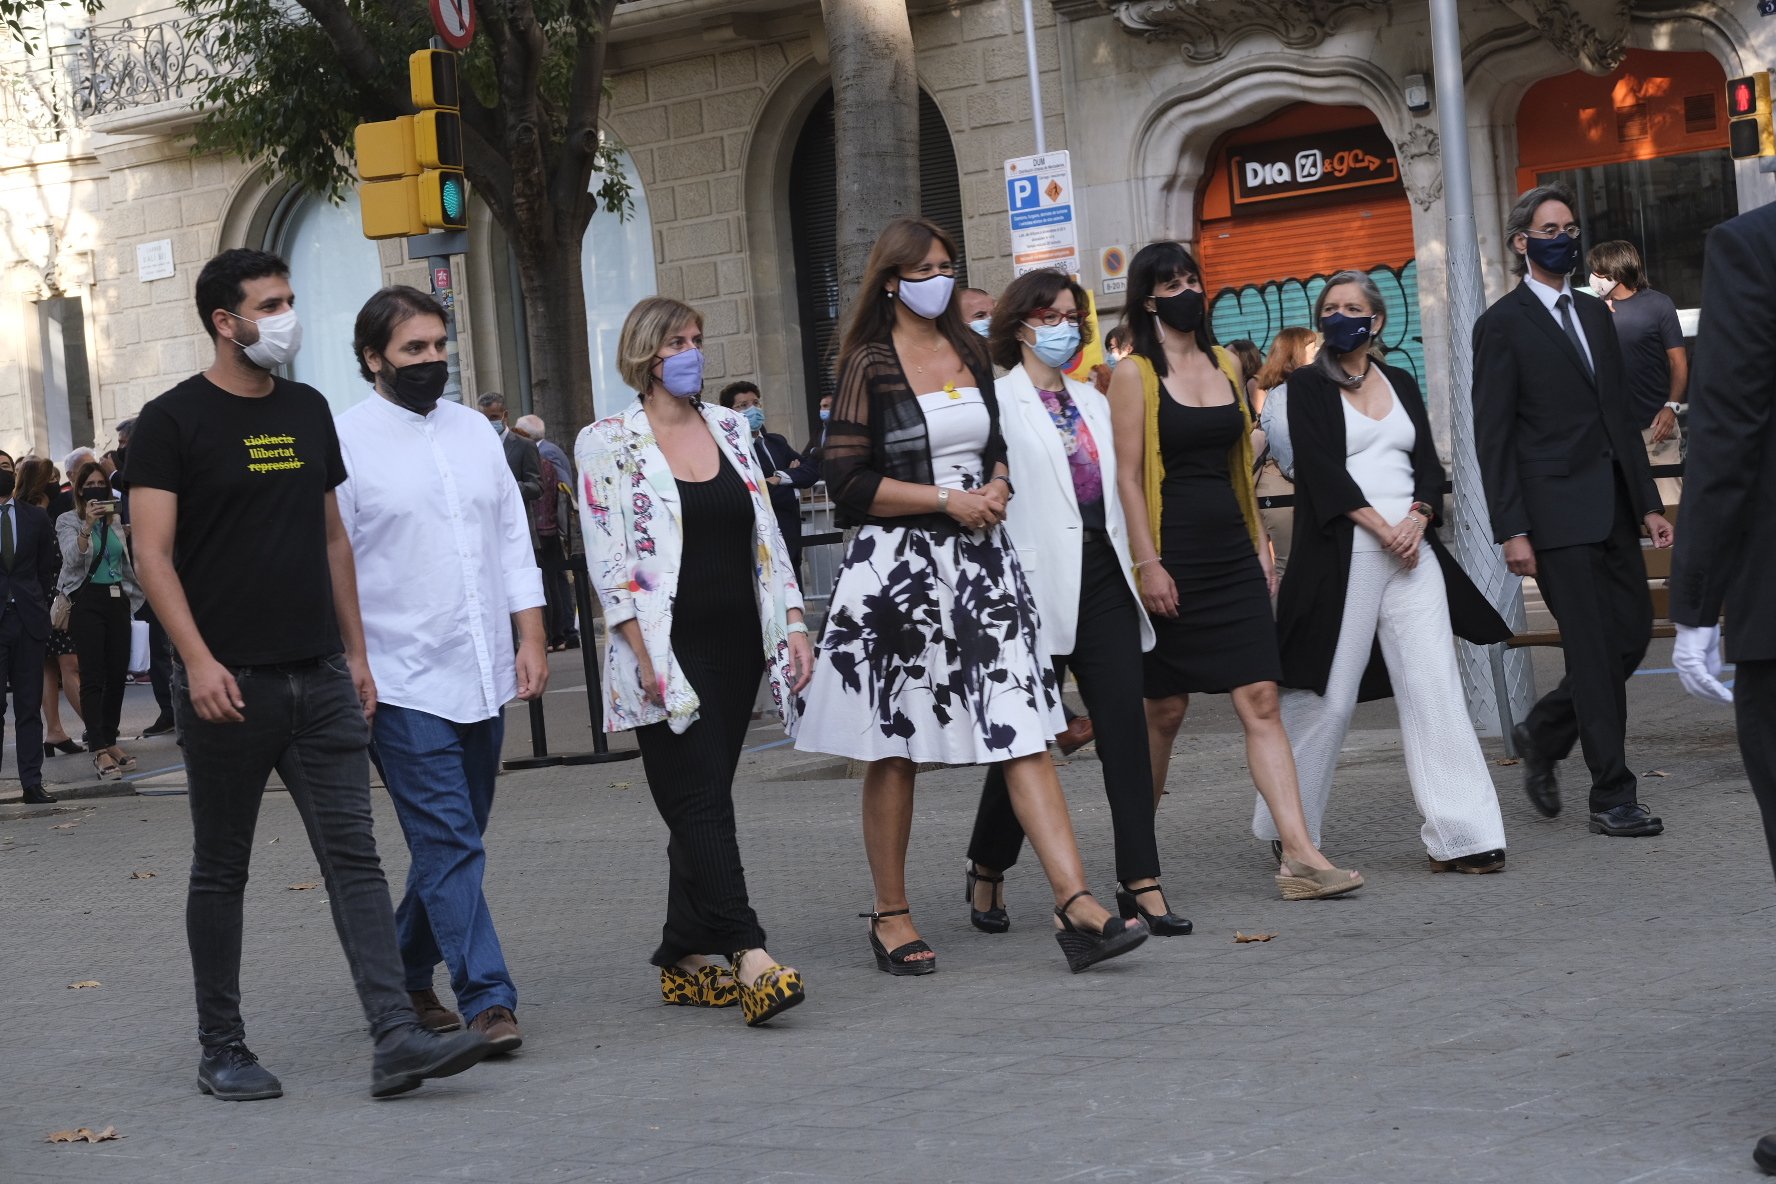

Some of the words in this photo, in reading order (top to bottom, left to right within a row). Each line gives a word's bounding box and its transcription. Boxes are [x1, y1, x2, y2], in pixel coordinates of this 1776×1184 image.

[1014, 179, 1032, 208] P
[243, 433, 296, 446] violència
[249, 447, 296, 459] llibertat
[247, 457, 302, 474] repressió
